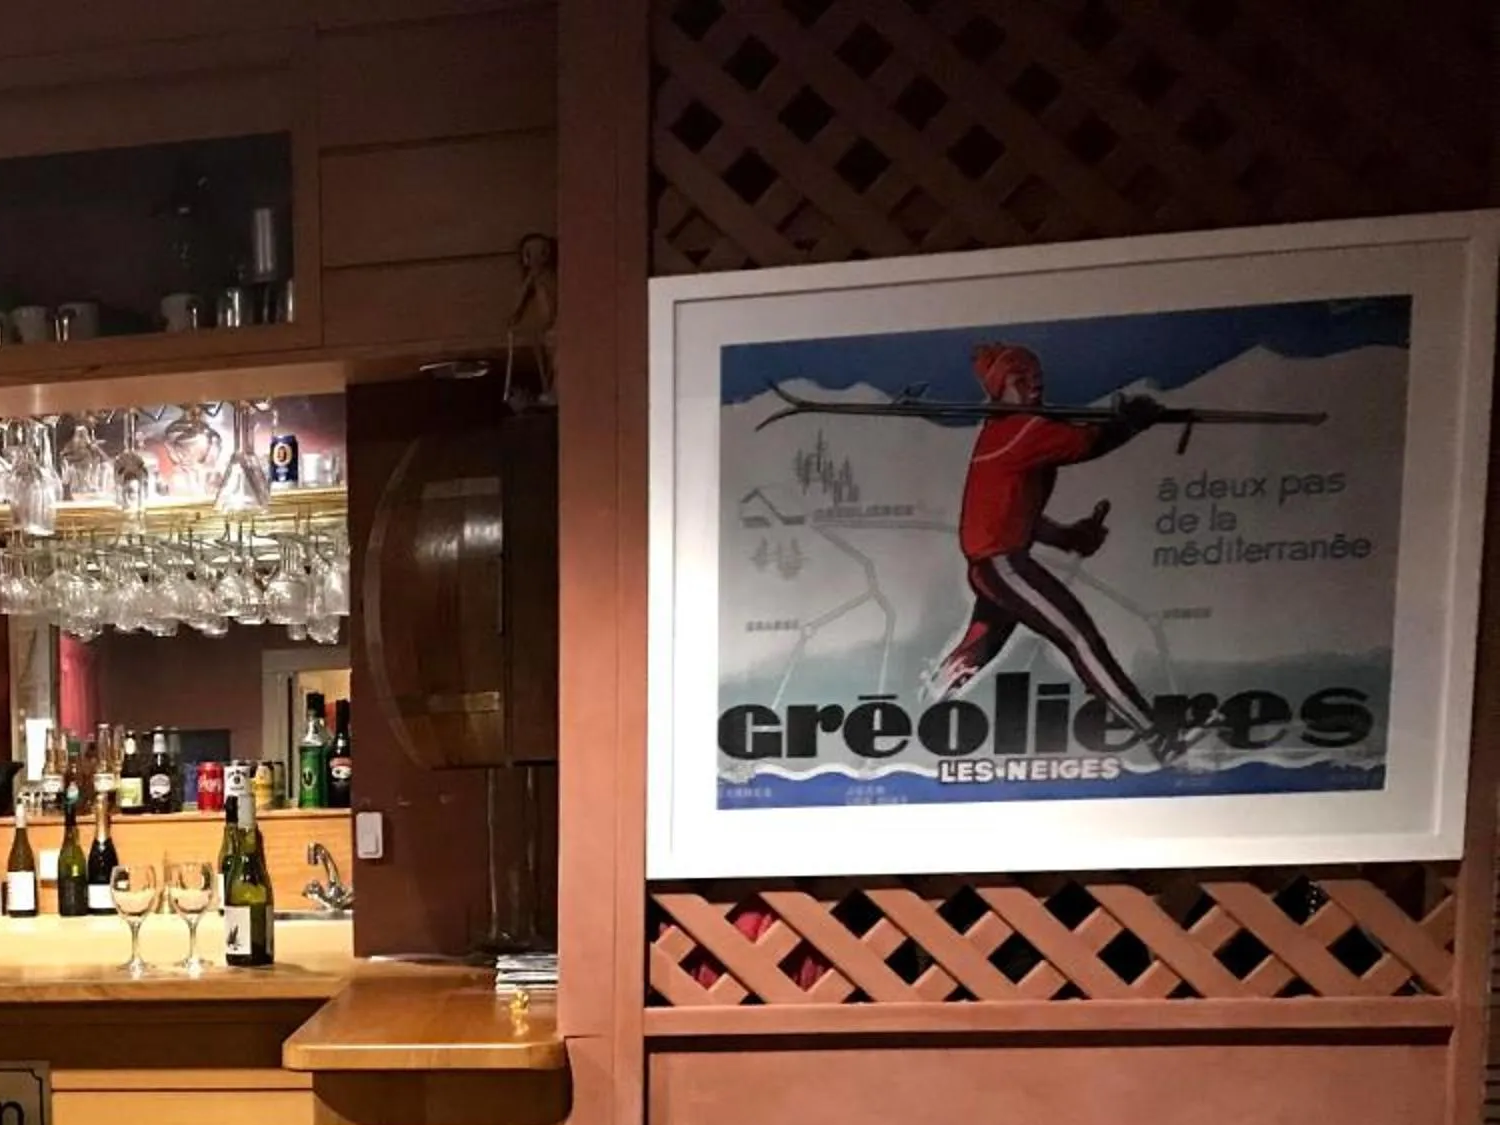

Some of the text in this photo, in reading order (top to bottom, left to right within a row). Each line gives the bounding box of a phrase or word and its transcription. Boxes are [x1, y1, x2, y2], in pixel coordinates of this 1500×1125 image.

[1184, 470, 1268, 501] deux
[1277, 472, 1346, 507] pas
[1155, 503, 1237, 536] de la
[939, 756, 1121, 783] LES NEIGES
